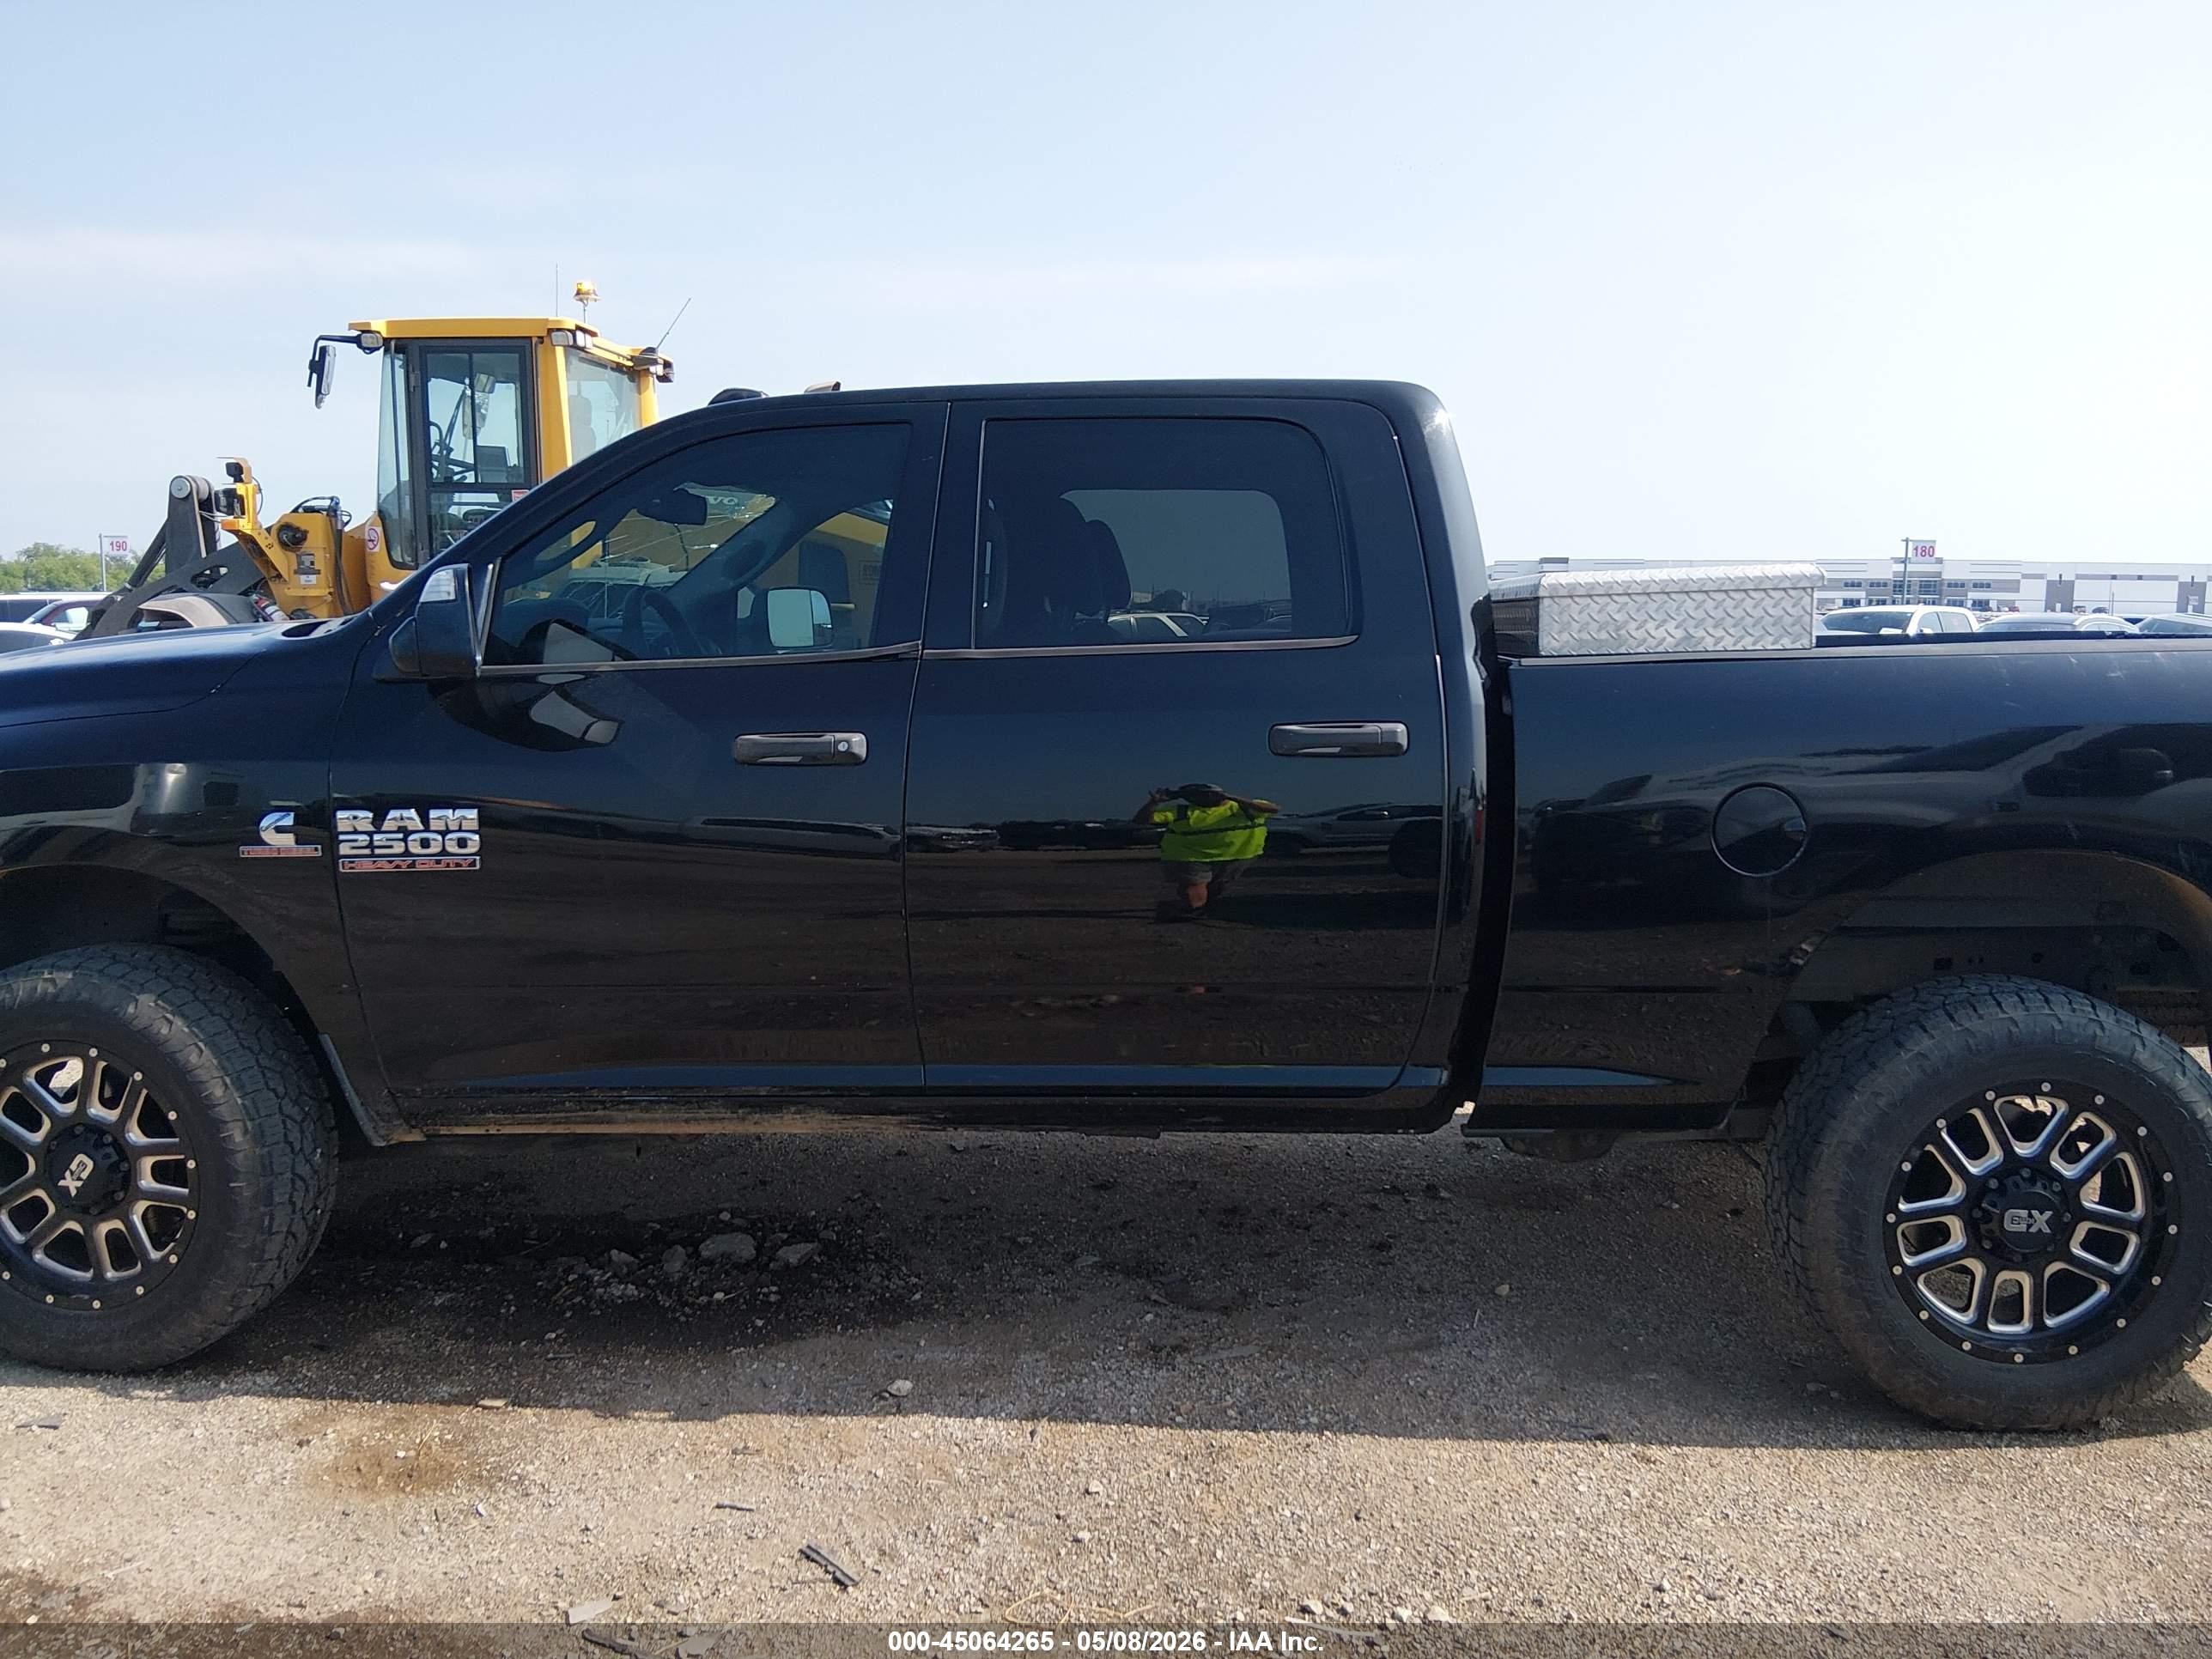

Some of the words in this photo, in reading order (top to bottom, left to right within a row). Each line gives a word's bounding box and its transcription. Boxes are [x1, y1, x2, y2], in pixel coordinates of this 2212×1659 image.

[109, 540, 128, 551] 190
[1913, 545, 1935, 558] 180
[336, 809, 479, 831] RAM
[338, 831, 481, 855] 2500
[343, 860, 412, 870] HEAVY
[415, 858, 473, 869] DUTY
